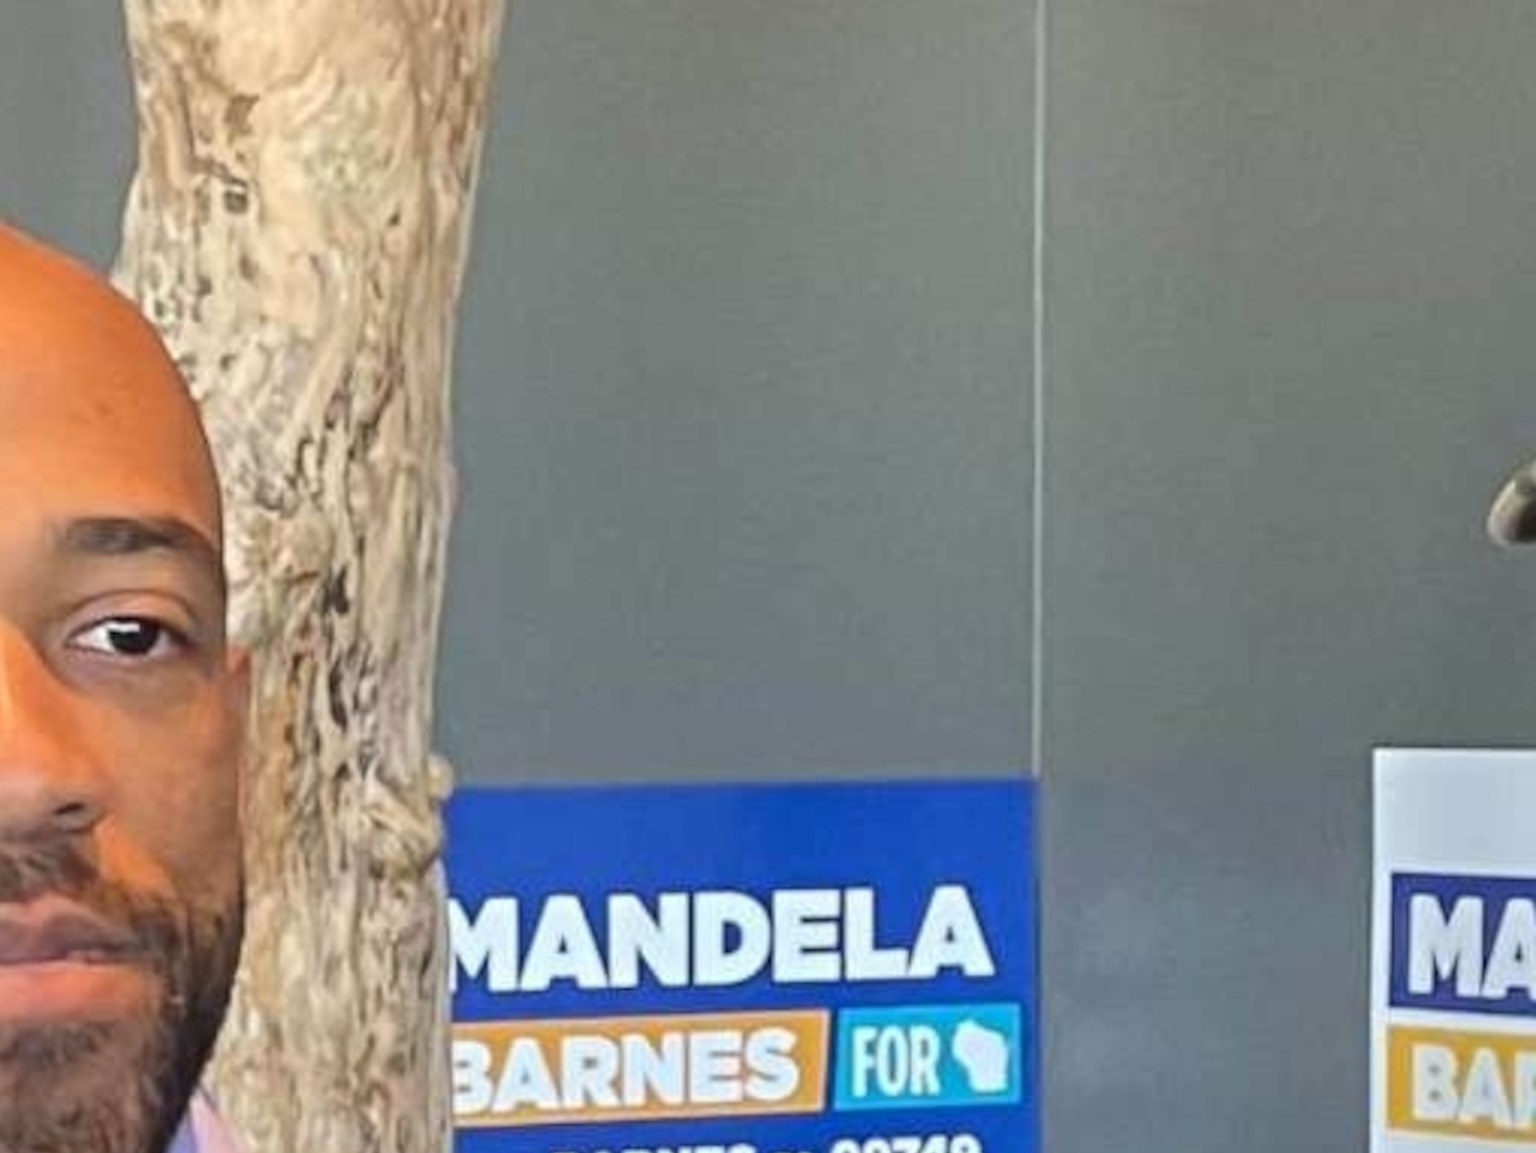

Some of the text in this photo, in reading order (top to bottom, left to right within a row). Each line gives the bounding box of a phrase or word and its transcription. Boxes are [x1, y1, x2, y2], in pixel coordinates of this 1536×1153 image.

[448, 885, 995, 993] MANDELA
[452, 1024, 942, 1115] BARNES FOR
